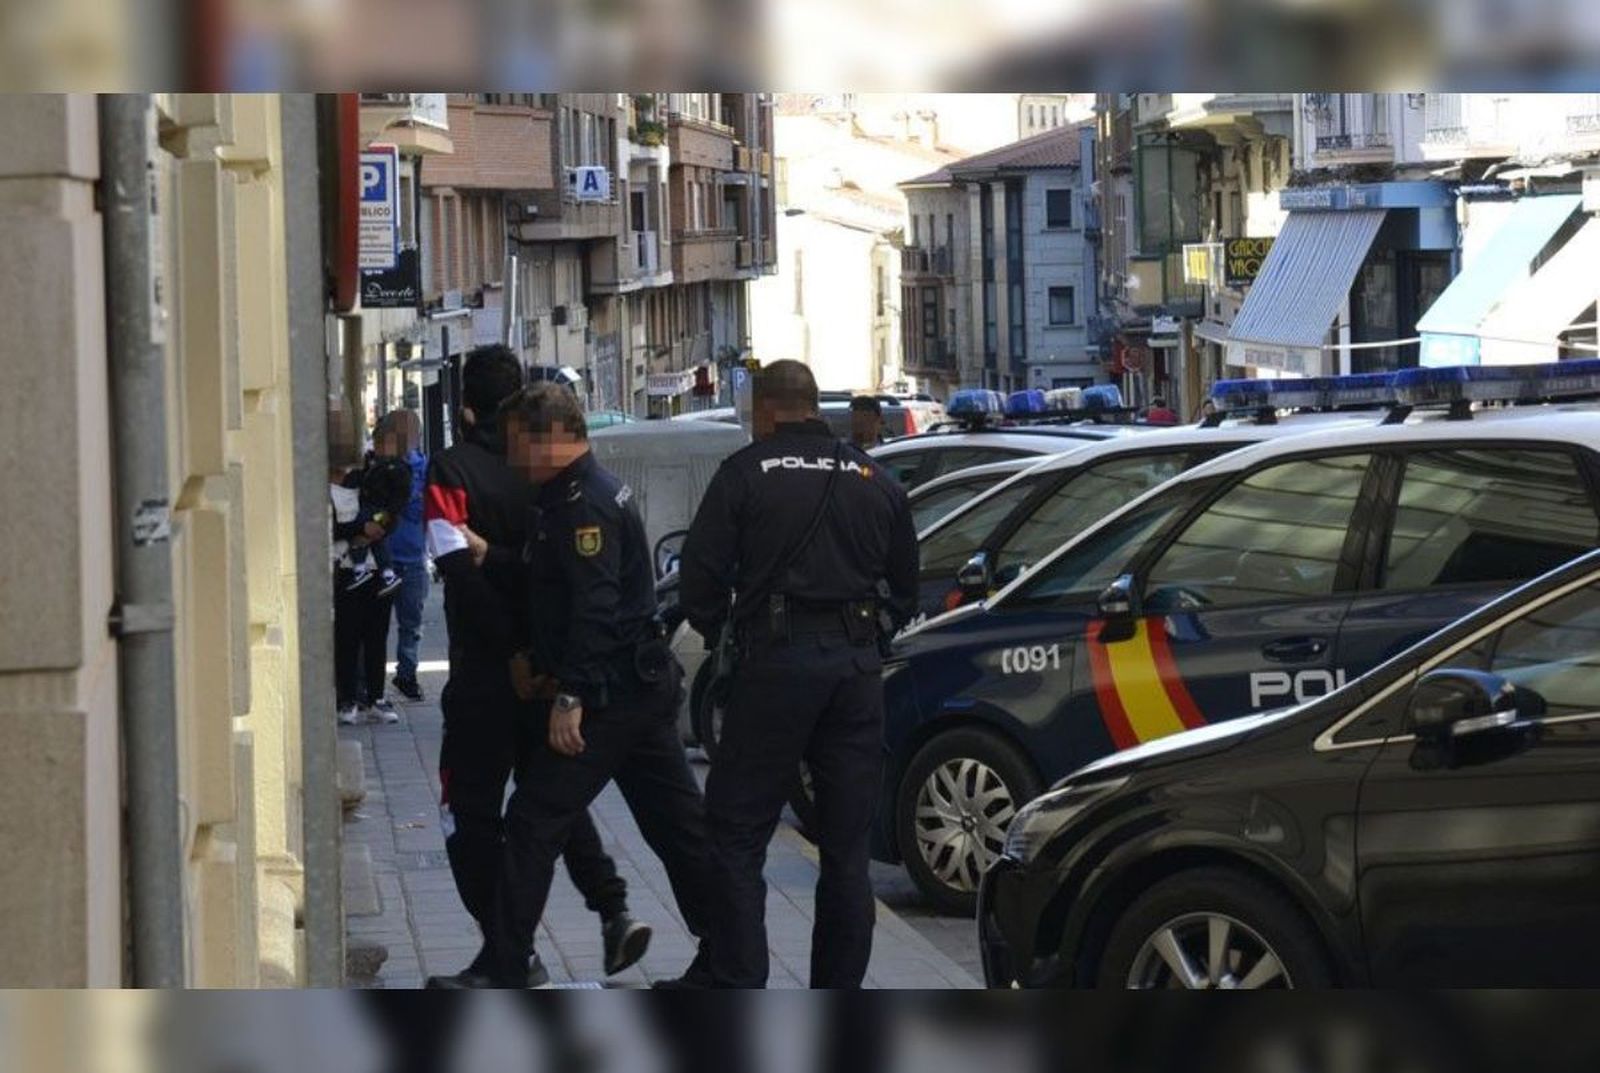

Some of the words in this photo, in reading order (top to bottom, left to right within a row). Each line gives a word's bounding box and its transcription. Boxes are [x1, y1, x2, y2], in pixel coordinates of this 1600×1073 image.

[360, 165, 380, 198] P
[583, 169, 599, 191] A
[360, 206, 391, 217] BLICO
[761, 456, 862, 473] POLICIA
[1012, 643, 1061, 674] 091
